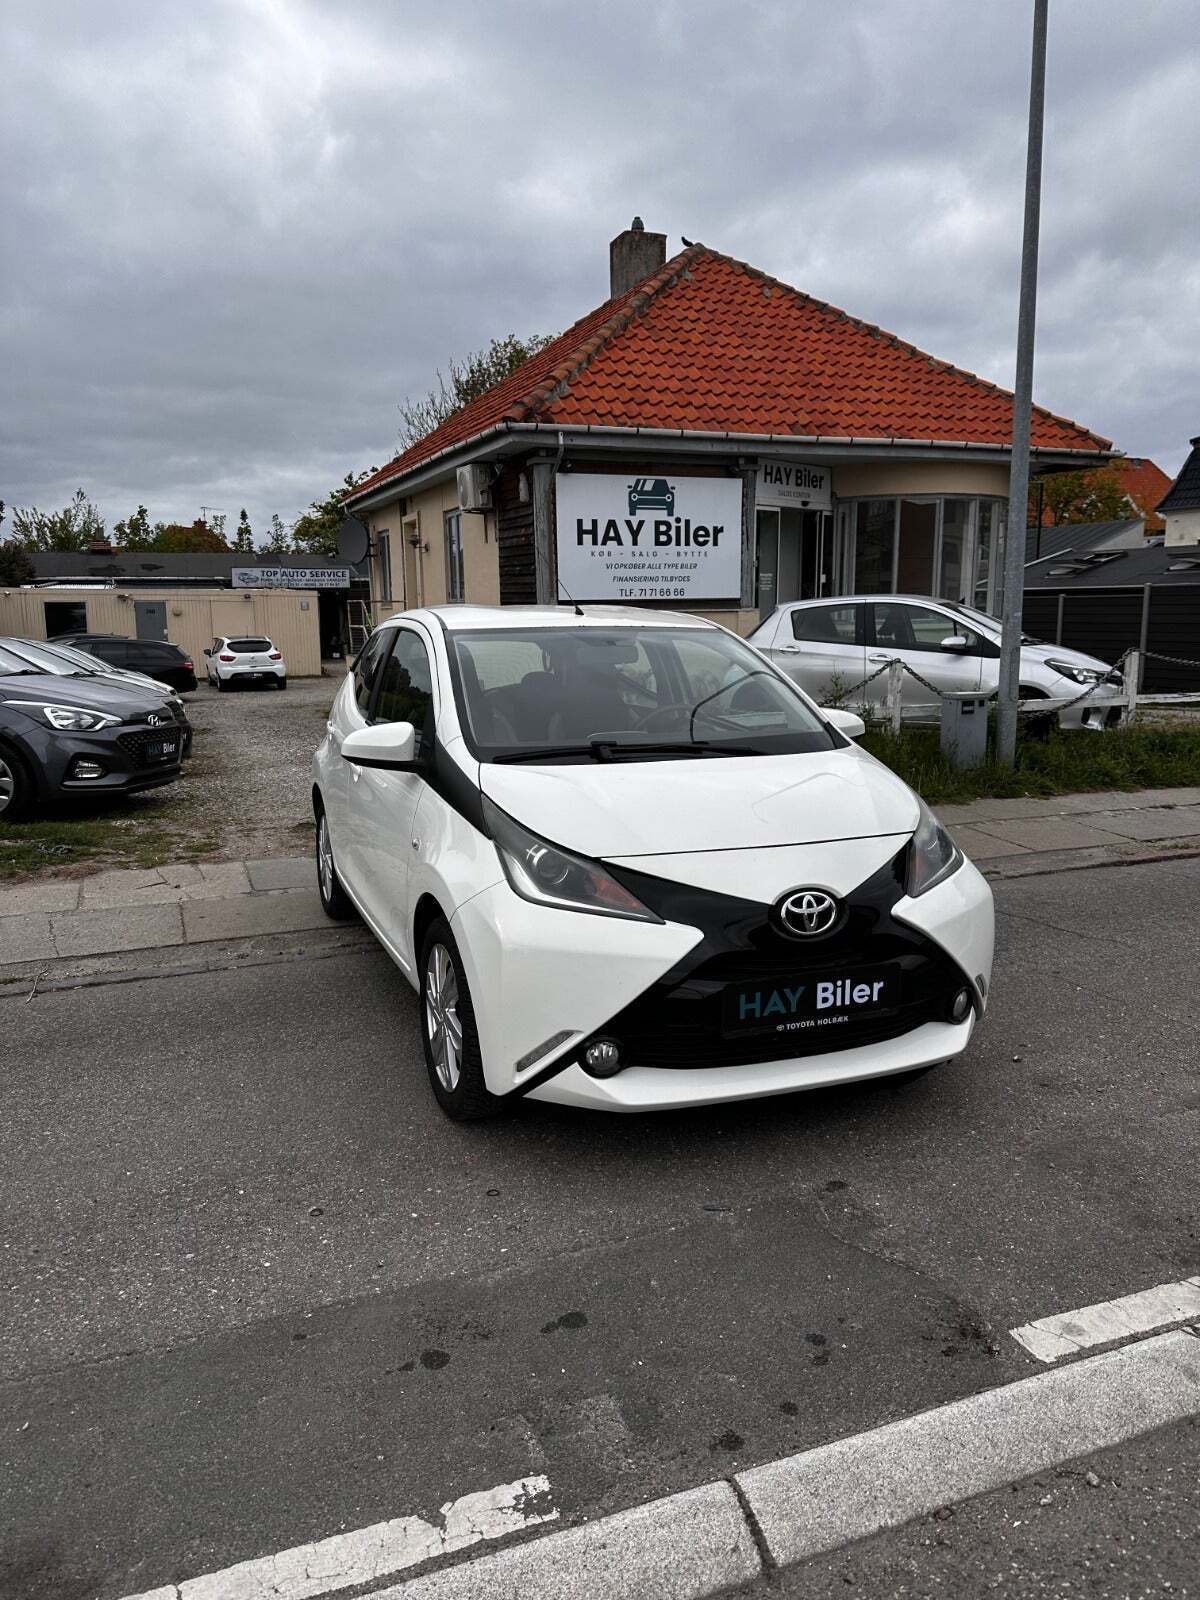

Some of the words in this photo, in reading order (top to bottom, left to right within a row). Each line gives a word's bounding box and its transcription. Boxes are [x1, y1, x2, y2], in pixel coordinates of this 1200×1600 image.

[764, 464, 792, 486] HAY
[795, 467, 825, 489] Biler
[576, 518, 646, 547] HAY
[654, 516, 724, 547] Biler
[281, 570, 307, 578] AUTO
[309, 570, 347, 578] SERVICE
[661, 575, 691, 583] TILBYDES
[619, 588, 637, 597] TLF.
[639, 588, 647, 597] 71
[649, 588, 658, 597] 71
[739, 986, 806, 1020] HAY
[816, 979, 884, 1010] Biler
[786, 1021, 815, 1030] TOYOTA
